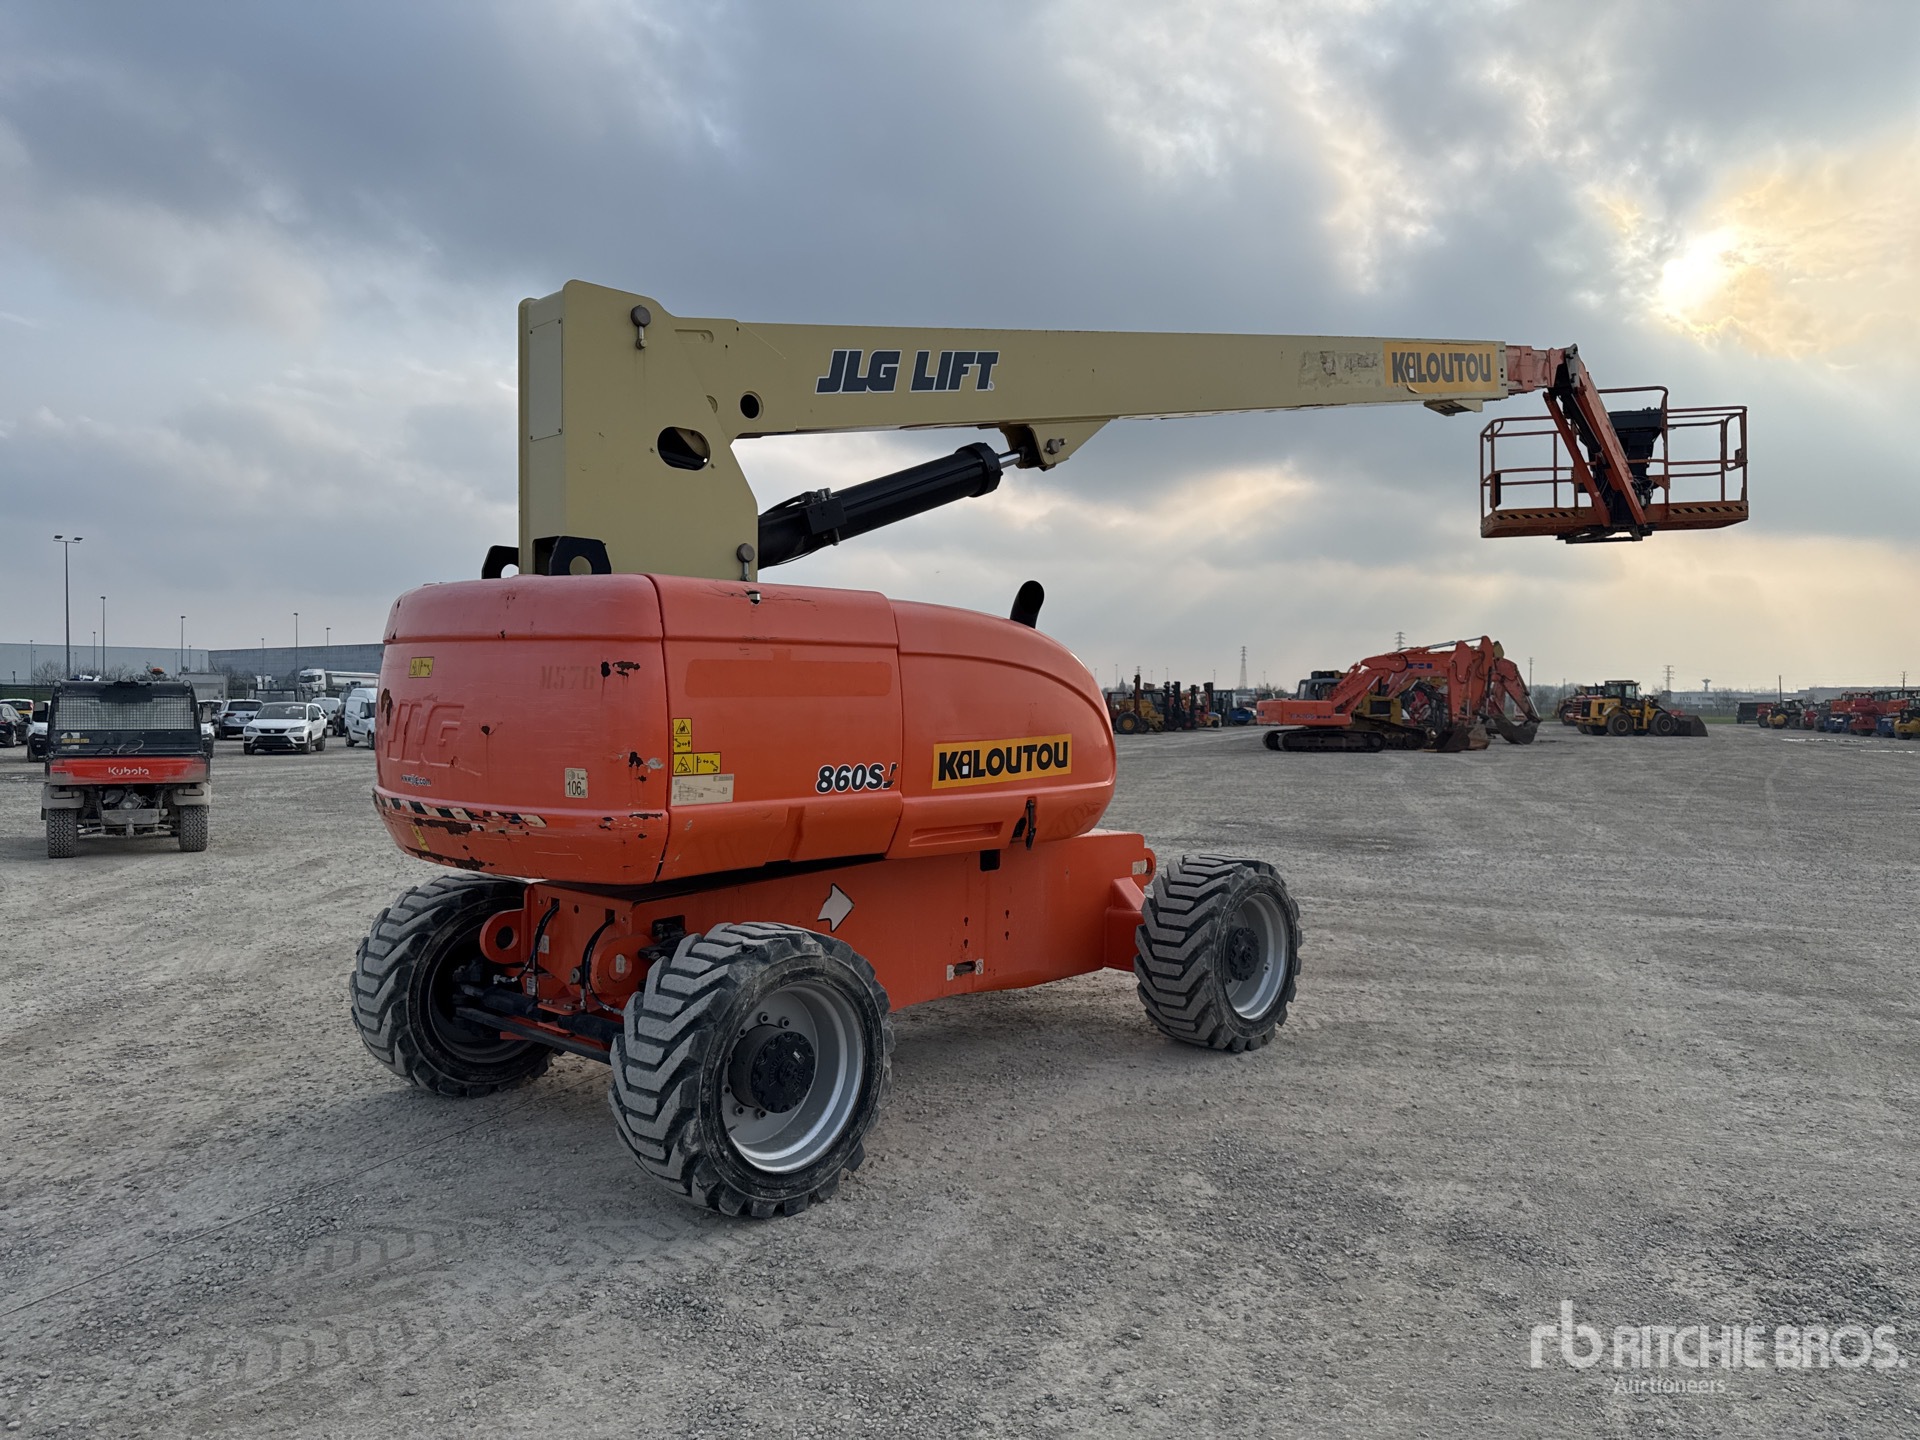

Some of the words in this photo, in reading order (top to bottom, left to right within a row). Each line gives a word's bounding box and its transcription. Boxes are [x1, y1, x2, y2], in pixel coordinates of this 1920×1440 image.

[815, 349, 902, 394] JLG
[1391, 351, 1492, 384] KILOUTOU
[108, 766, 150, 775] Kubota
[938, 741, 1068, 781] KILOUTOU
[567, 780, 582, 796] 106
